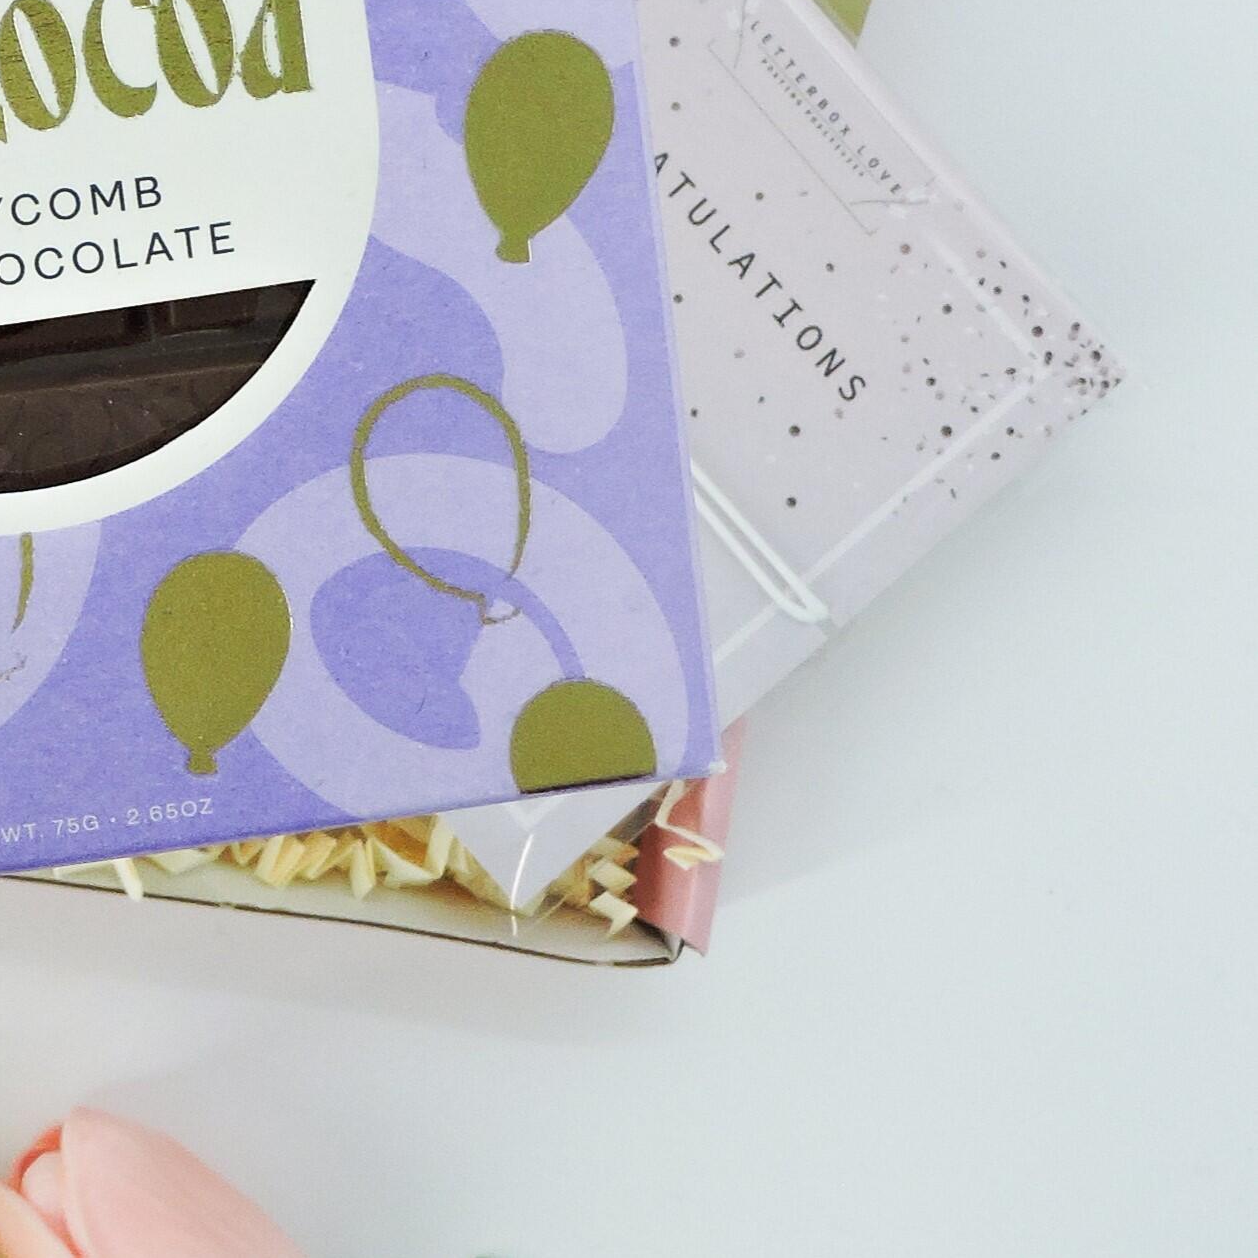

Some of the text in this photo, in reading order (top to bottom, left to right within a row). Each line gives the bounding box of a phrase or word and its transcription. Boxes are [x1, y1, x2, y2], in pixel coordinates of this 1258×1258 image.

[750, 20, 851, 137] LETTERBOX
[856, 144, 902, 194] LOVE
[0, 822, 44, 844] WT.
[52, 814, 100, 837] 75G
